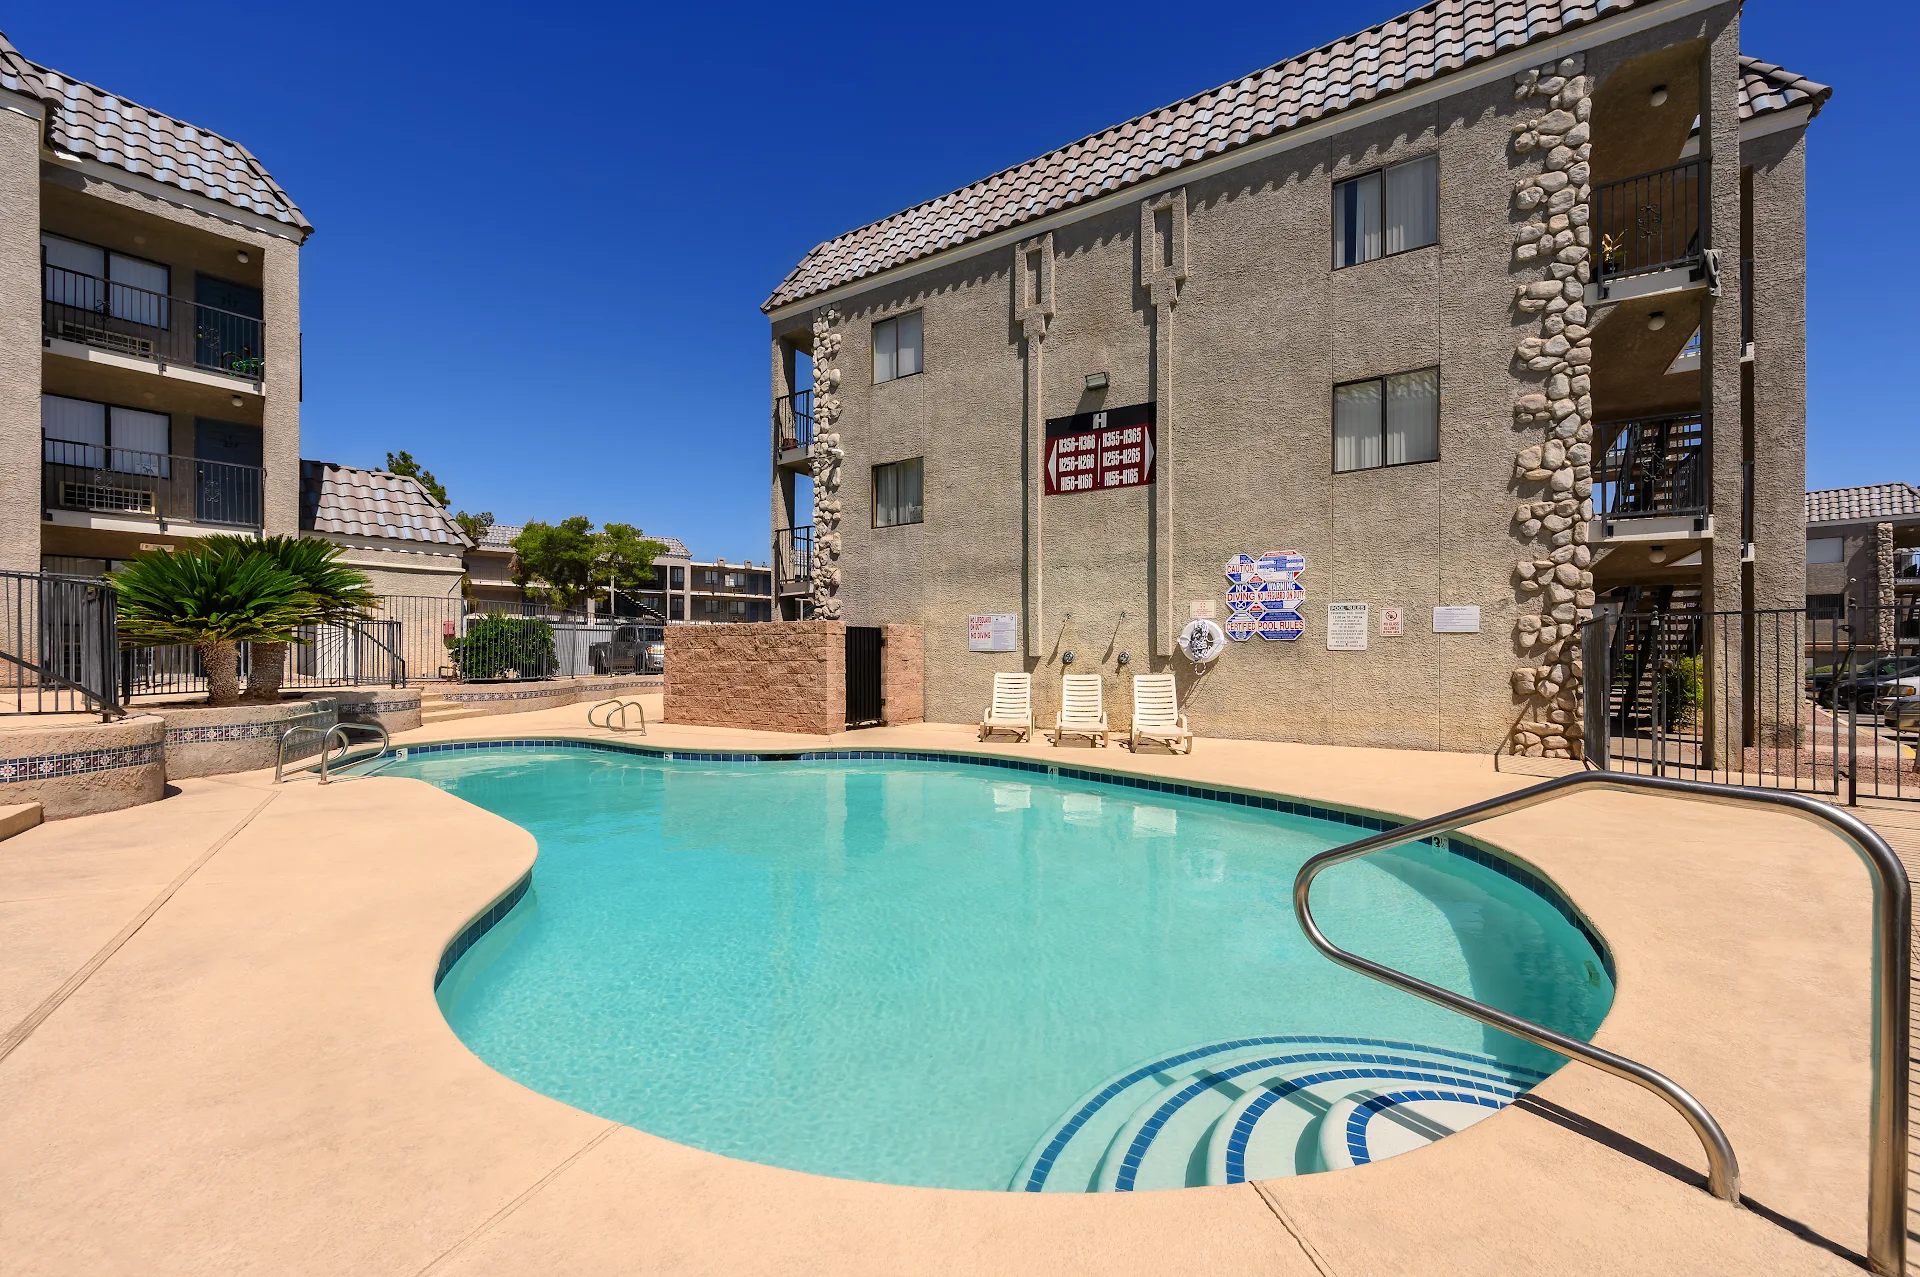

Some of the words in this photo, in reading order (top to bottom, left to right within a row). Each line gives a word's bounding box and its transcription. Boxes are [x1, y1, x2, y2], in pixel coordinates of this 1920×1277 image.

[1092, 412, 1108, 430] H
[1102, 427, 1142, 448] H355-H365
[1102, 447, 1141, 467] H255-H265
[1226, 564, 1255, 574] CAUTION
[1235, 584, 1248, 592] NO
[1267, 581, 1296, 591] WARNING
[1227, 592, 1255, 601] DIVING
[1226, 622, 1256, 631] CERTIFIED
[1258, 621, 1278, 630] POOL
[1279, 620, 1304, 630] RULES
